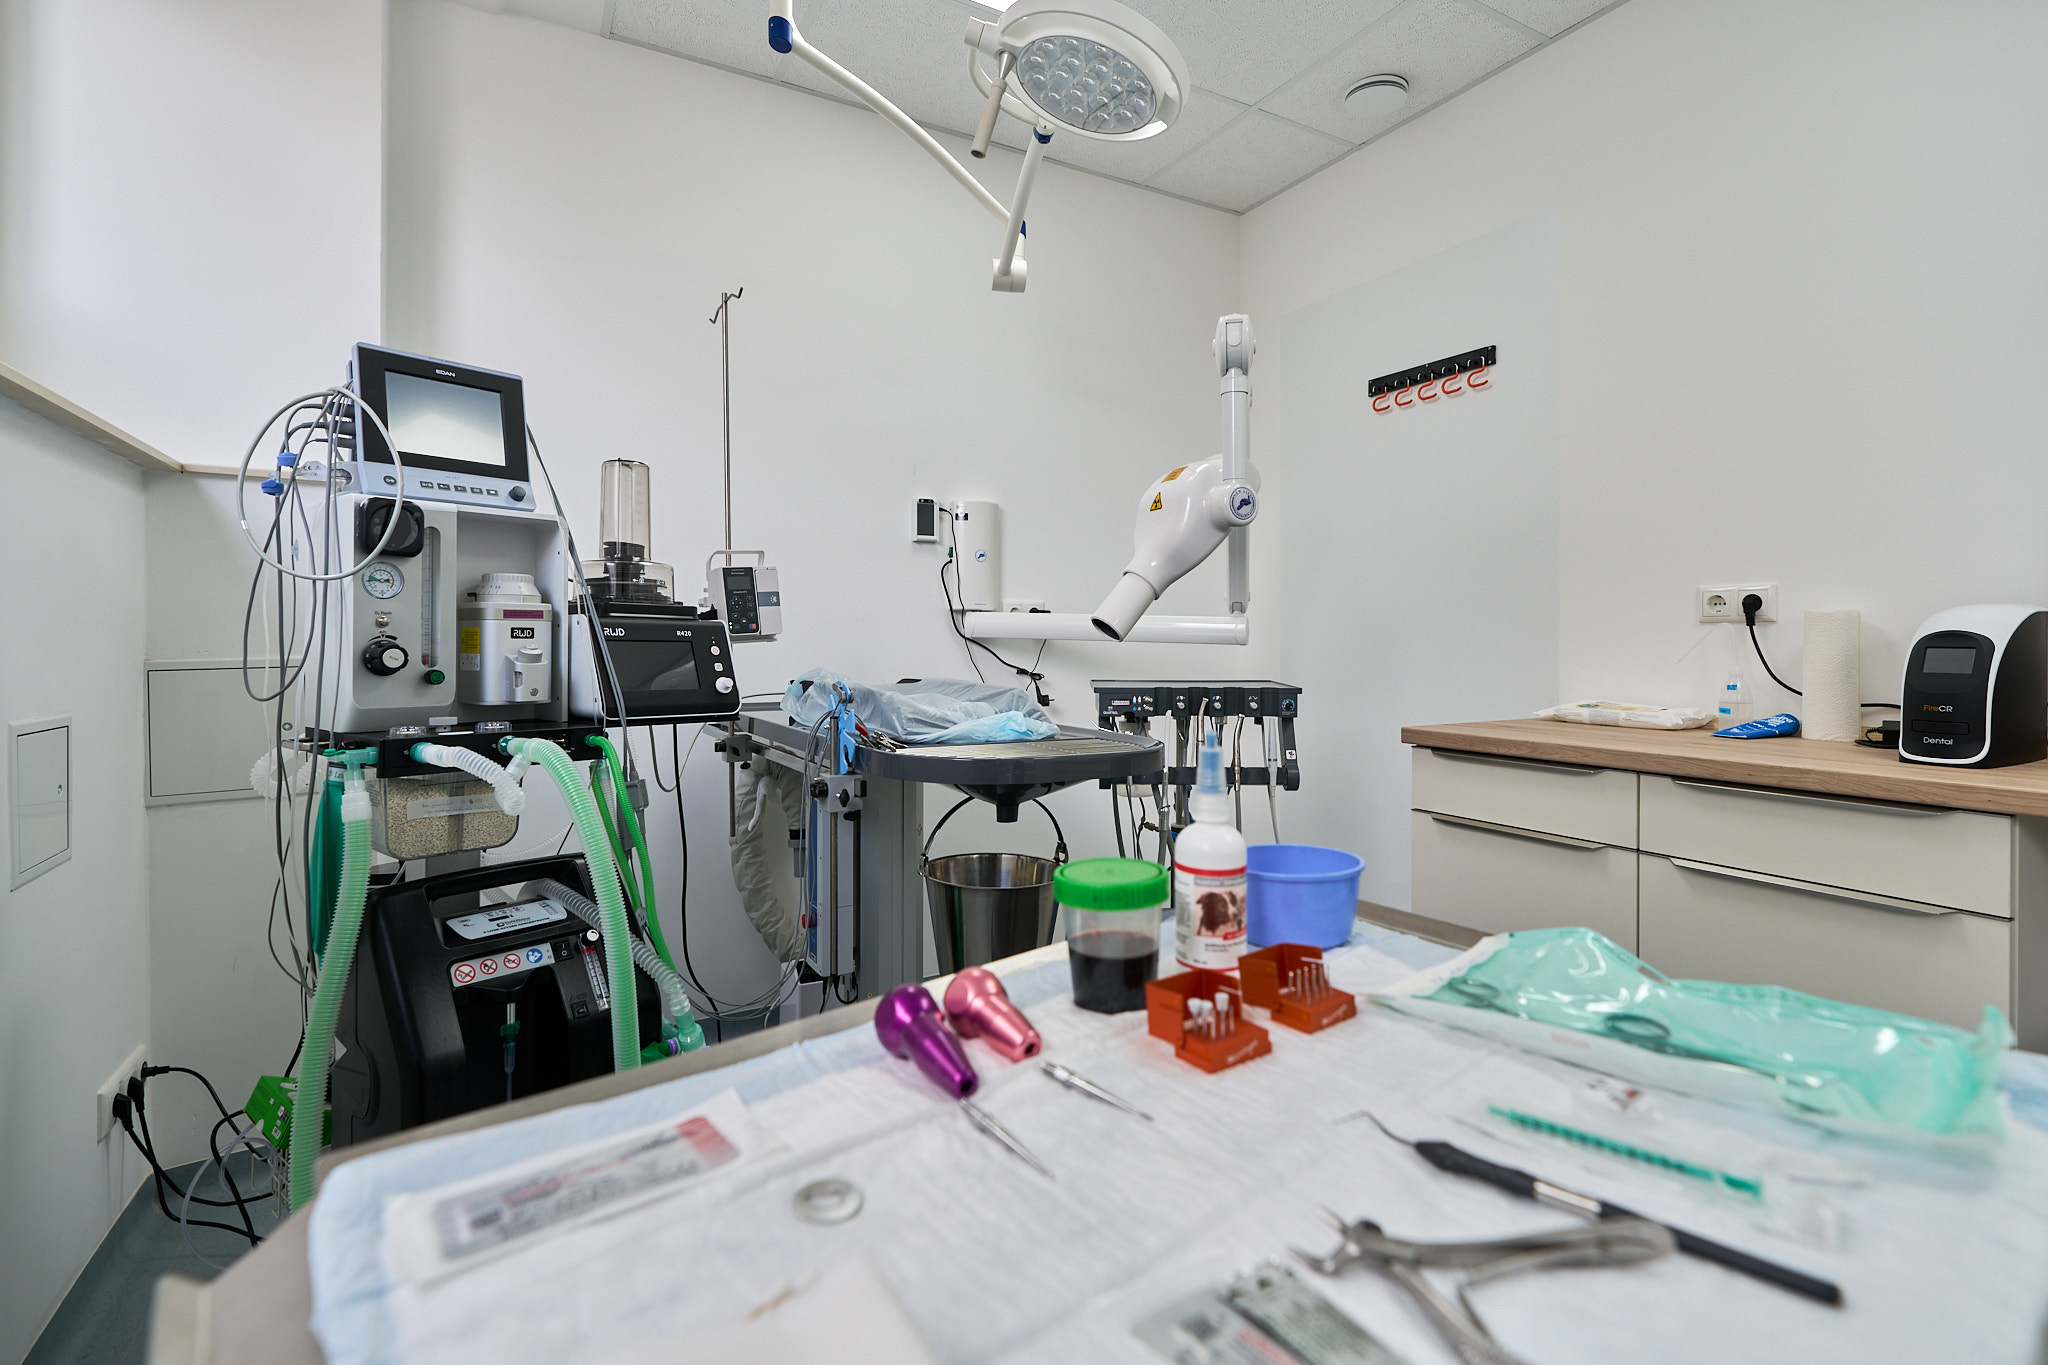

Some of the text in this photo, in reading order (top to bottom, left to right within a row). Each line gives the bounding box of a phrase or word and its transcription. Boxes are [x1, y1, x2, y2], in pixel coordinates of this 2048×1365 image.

[435, 369, 455, 377] EDAN
[513, 629, 533, 637] RWD
[603, 627, 625, 637] RWD
[1923, 704, 1953, 712] FireCR
[1923, 736, 1953, 745] Dental
